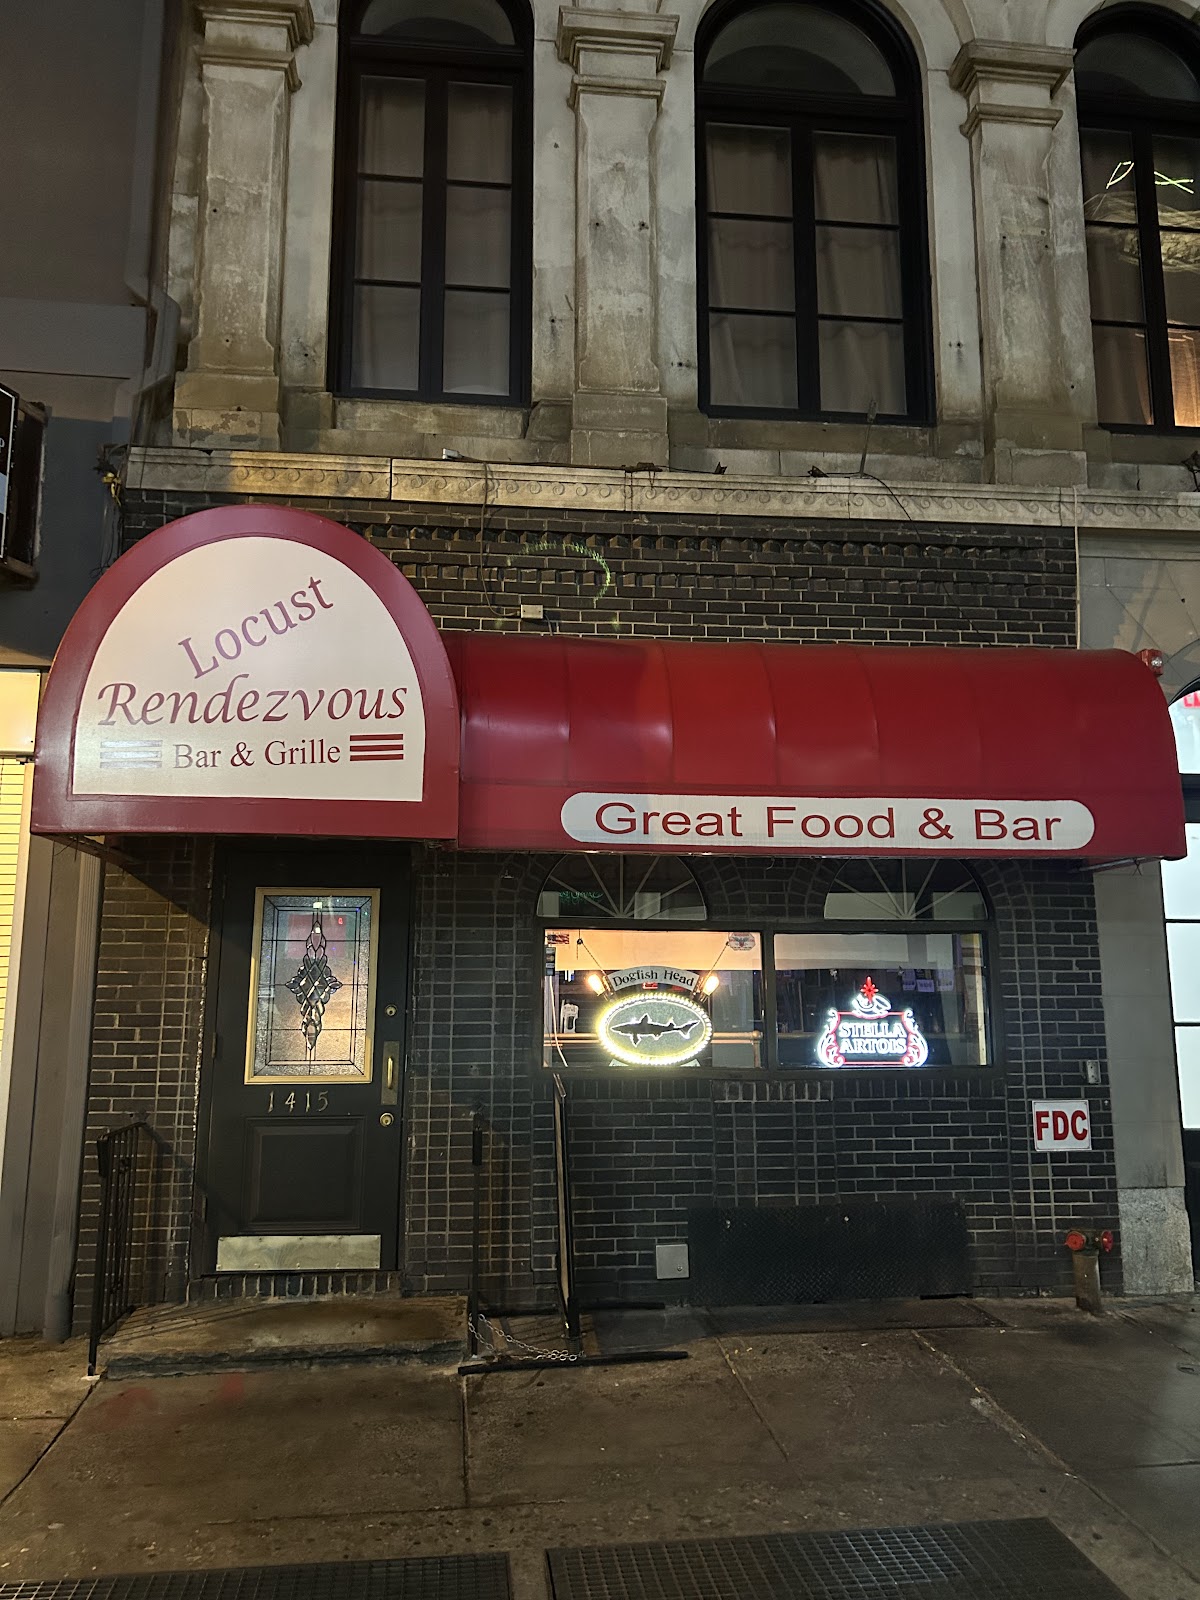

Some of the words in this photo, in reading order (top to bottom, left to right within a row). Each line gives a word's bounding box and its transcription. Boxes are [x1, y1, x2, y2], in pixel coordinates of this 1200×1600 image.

[177, 575, 334, 680] Locust
[97, 673, 408, 727] Rendezvous
[173, 743, 222, 769] Bar
[230, 742, 255, 768] &
[264, 739, 342, 766] Grille
[595, 802, 743, 837] Great
[766, 806, 895, 840] Food
[918, 807, 953, 840] &
[974, 808, 1062, 842] Bar
[612, 969, 658, 987] Dogfish
[663, 969, 695, 987] Head
[838, 1022, 906, 1038] STELLA
[839, 1038, 907, 1054] ARTOIS
[268, 1091, 329, 1113] 1415
[1035, 1109, 1088, 1141] FDC
